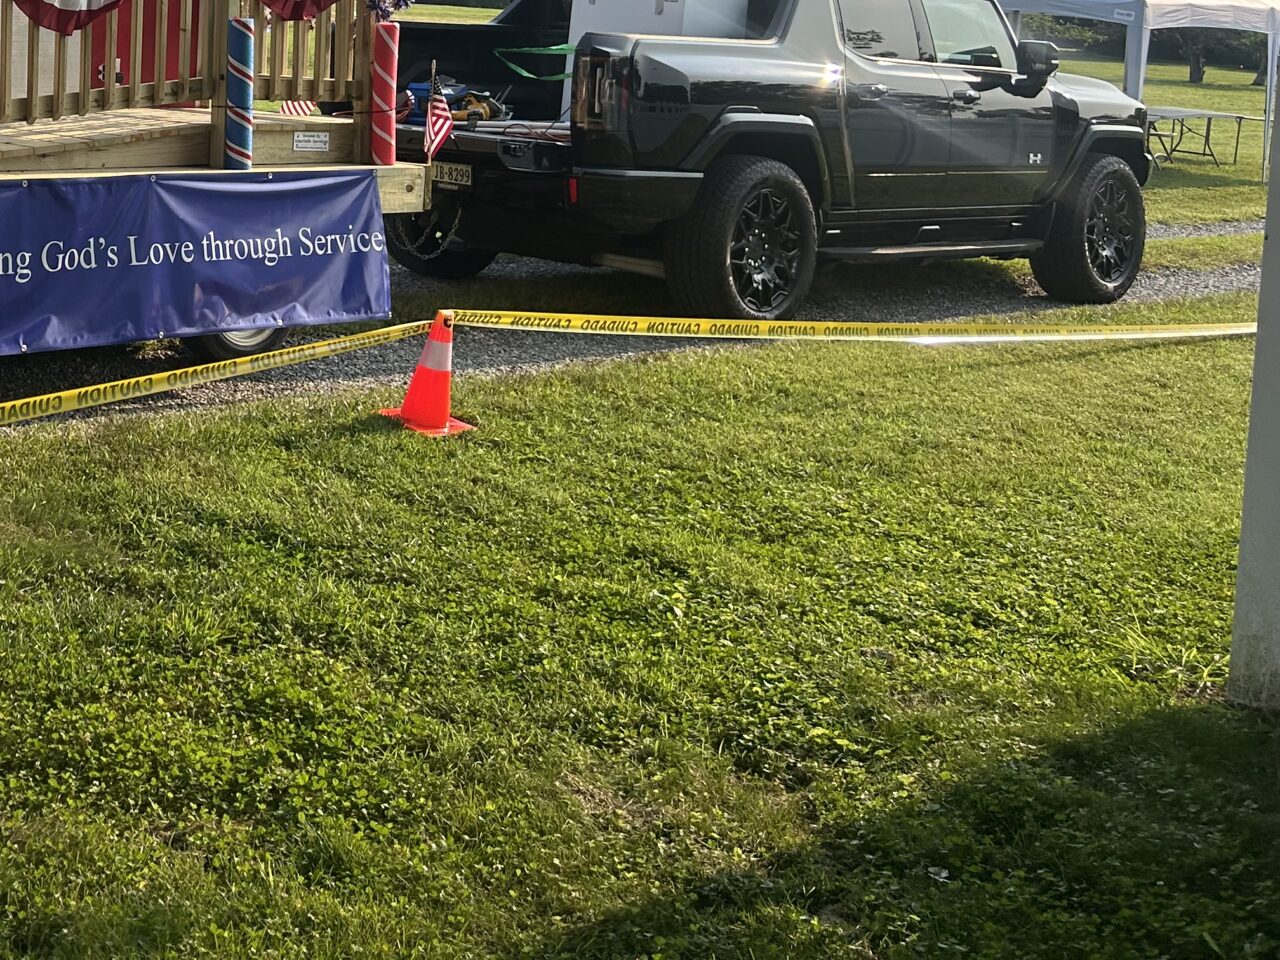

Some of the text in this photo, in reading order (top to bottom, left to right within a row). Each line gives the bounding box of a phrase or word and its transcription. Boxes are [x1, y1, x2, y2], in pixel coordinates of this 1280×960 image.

[41, 236, 119, 273] God’s
[129, 234, 194, 267] Love
[201, 227, 293, 267] through
[298, 223, 385, 258] Service
